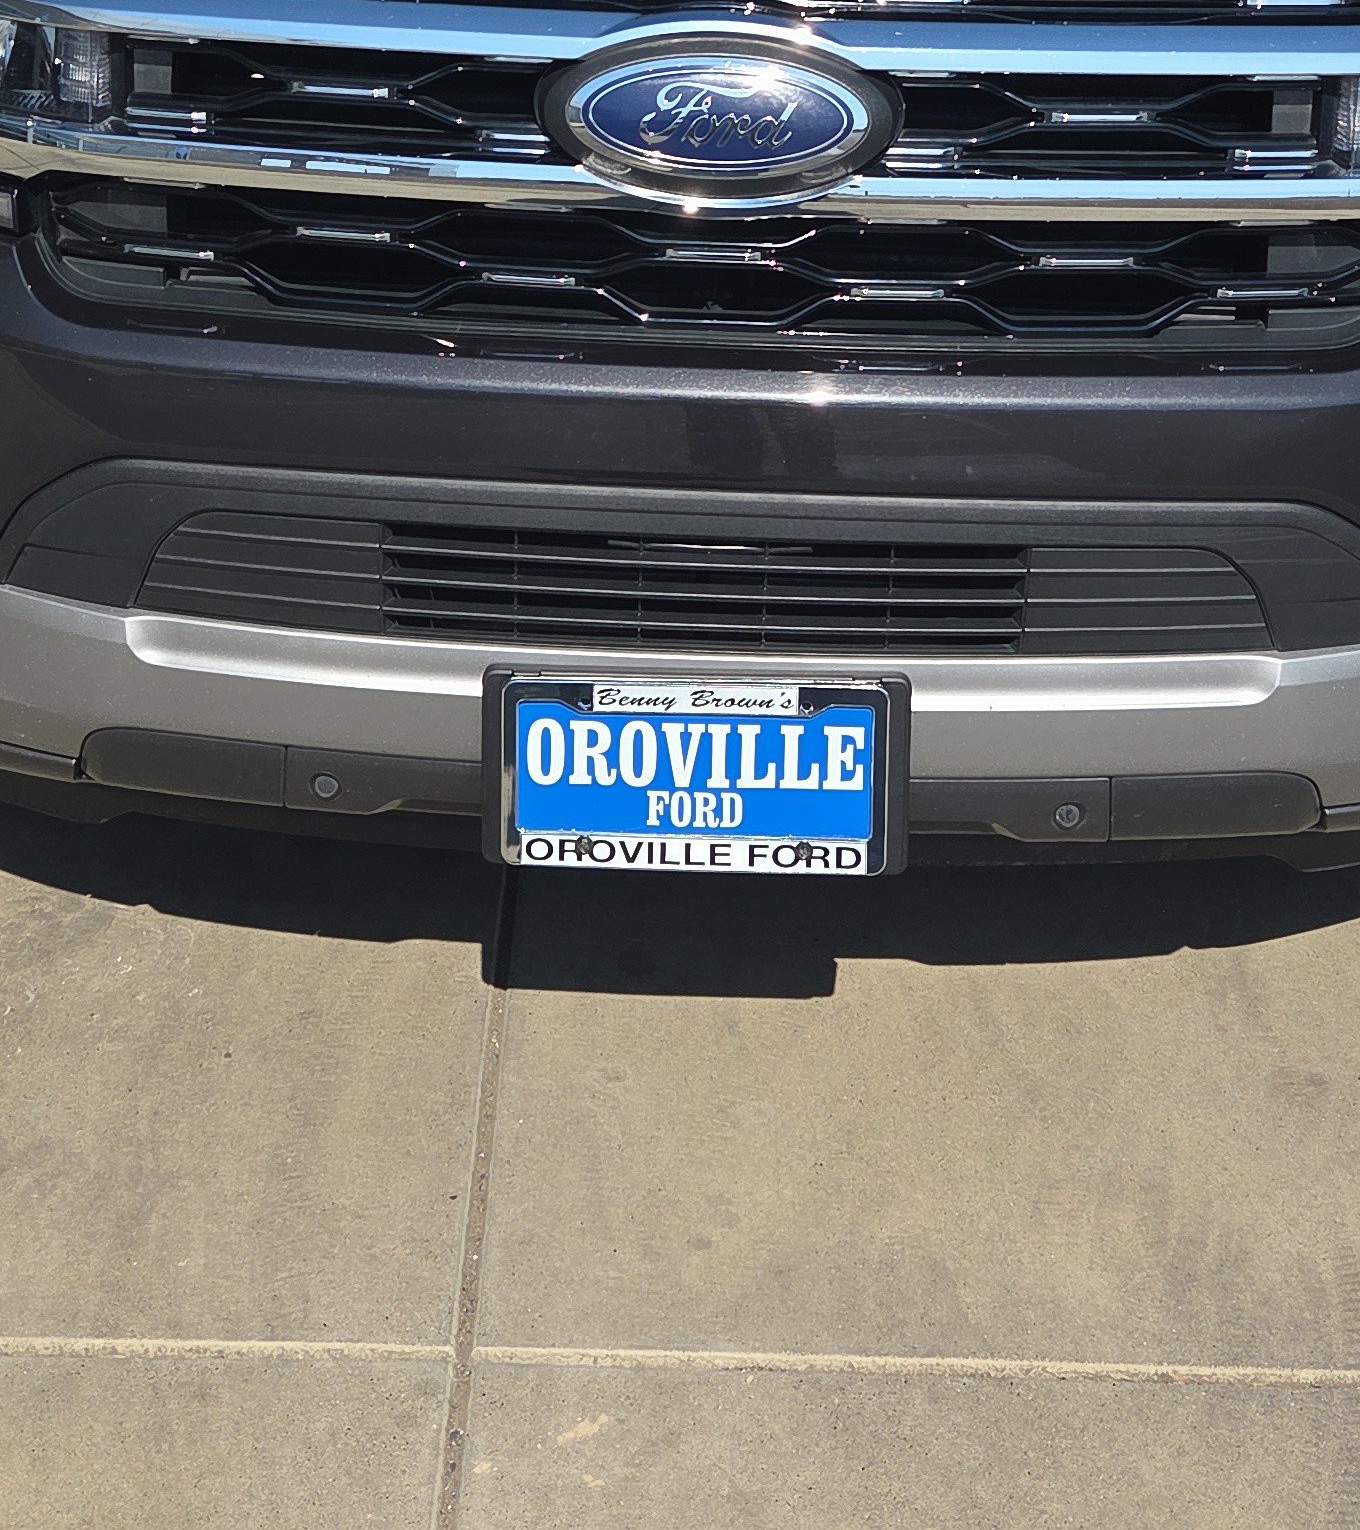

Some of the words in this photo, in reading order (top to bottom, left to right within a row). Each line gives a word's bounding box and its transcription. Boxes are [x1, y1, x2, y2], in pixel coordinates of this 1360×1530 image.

[640, 81, 798, 150] Ford
[597, 688, 677, 710] Benny
[690, 690, 794, 710] Brown's
[526, 718, 866, 791] OROVILLE
[646, 790, 743, 828] FORD
[525, 837, 732, 867] OROVILLE
[748, 844, 862, 870] FORD
